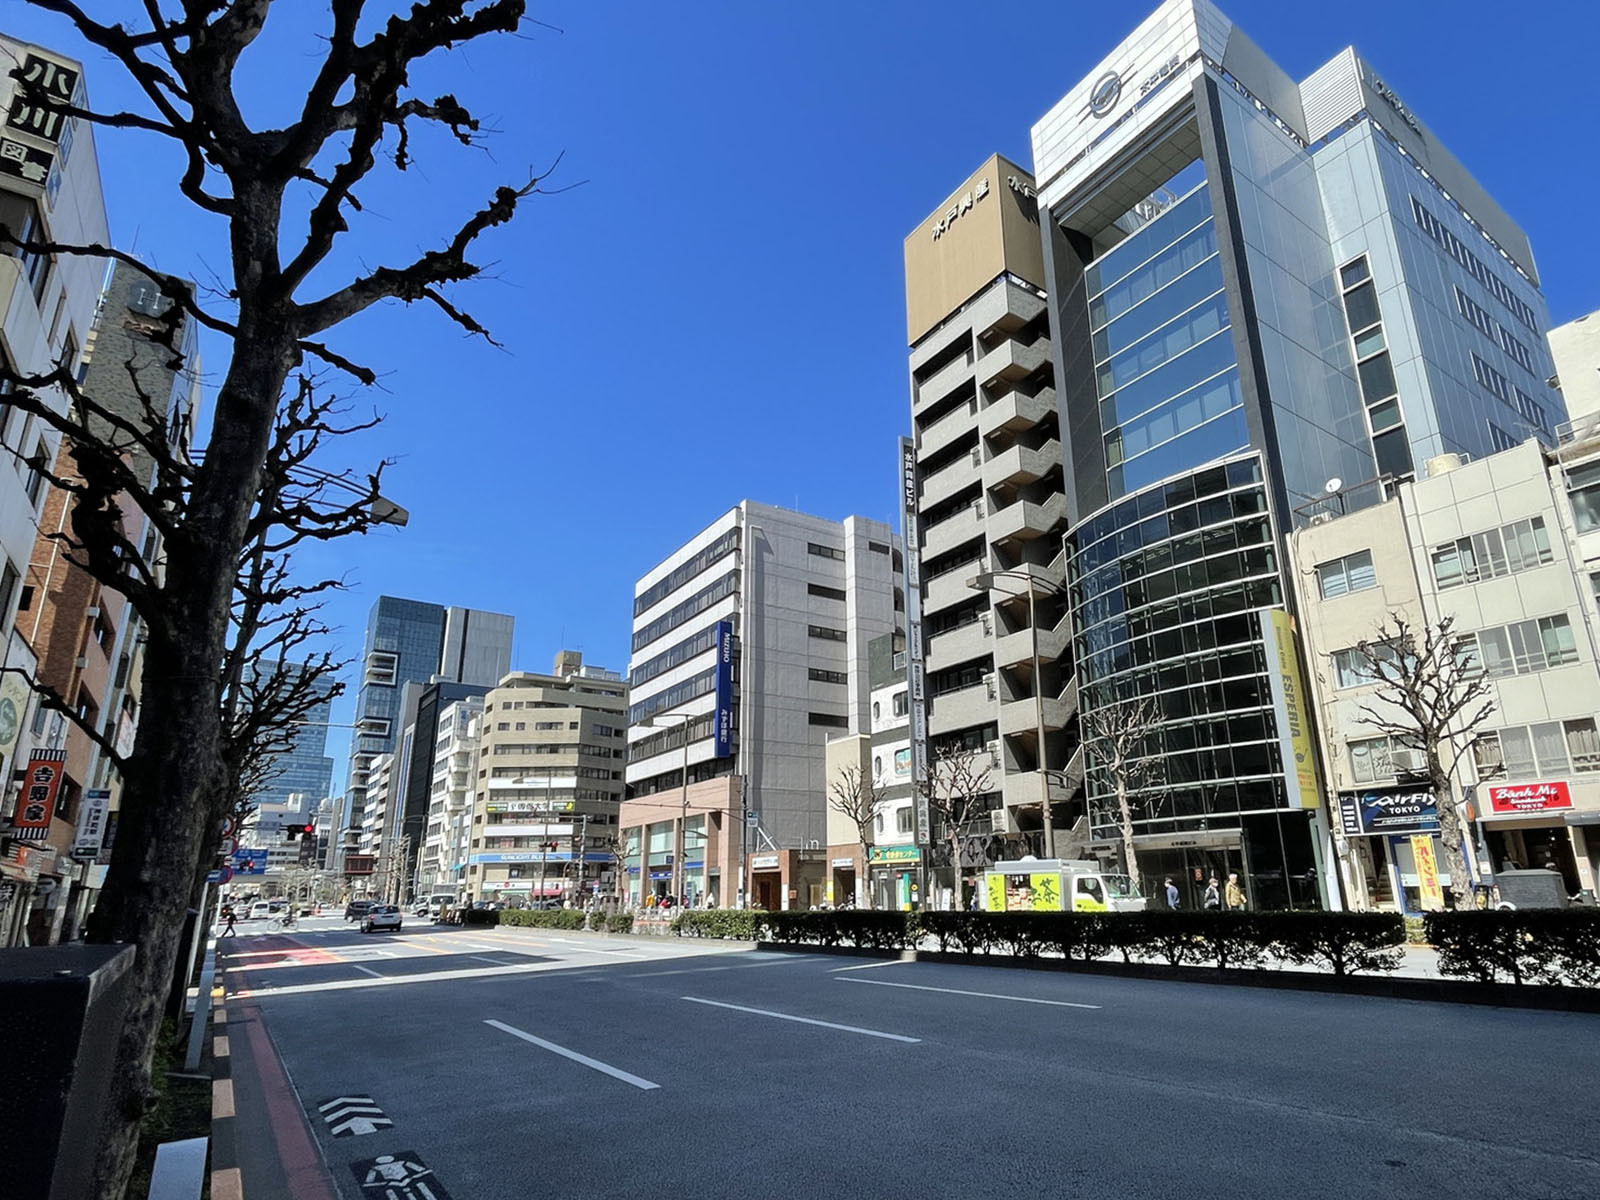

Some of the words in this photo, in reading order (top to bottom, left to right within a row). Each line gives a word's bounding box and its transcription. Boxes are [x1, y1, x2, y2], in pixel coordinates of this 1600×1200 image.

[12, 62, 70, 138] 小川
[931, 177, 990, 241] 水戸興産
[723, 633, 731, 663] MIZUHO
[1282, 674, 1301, 738] ESPERIA
[1389, 806, 1421, 814] TOKYO
